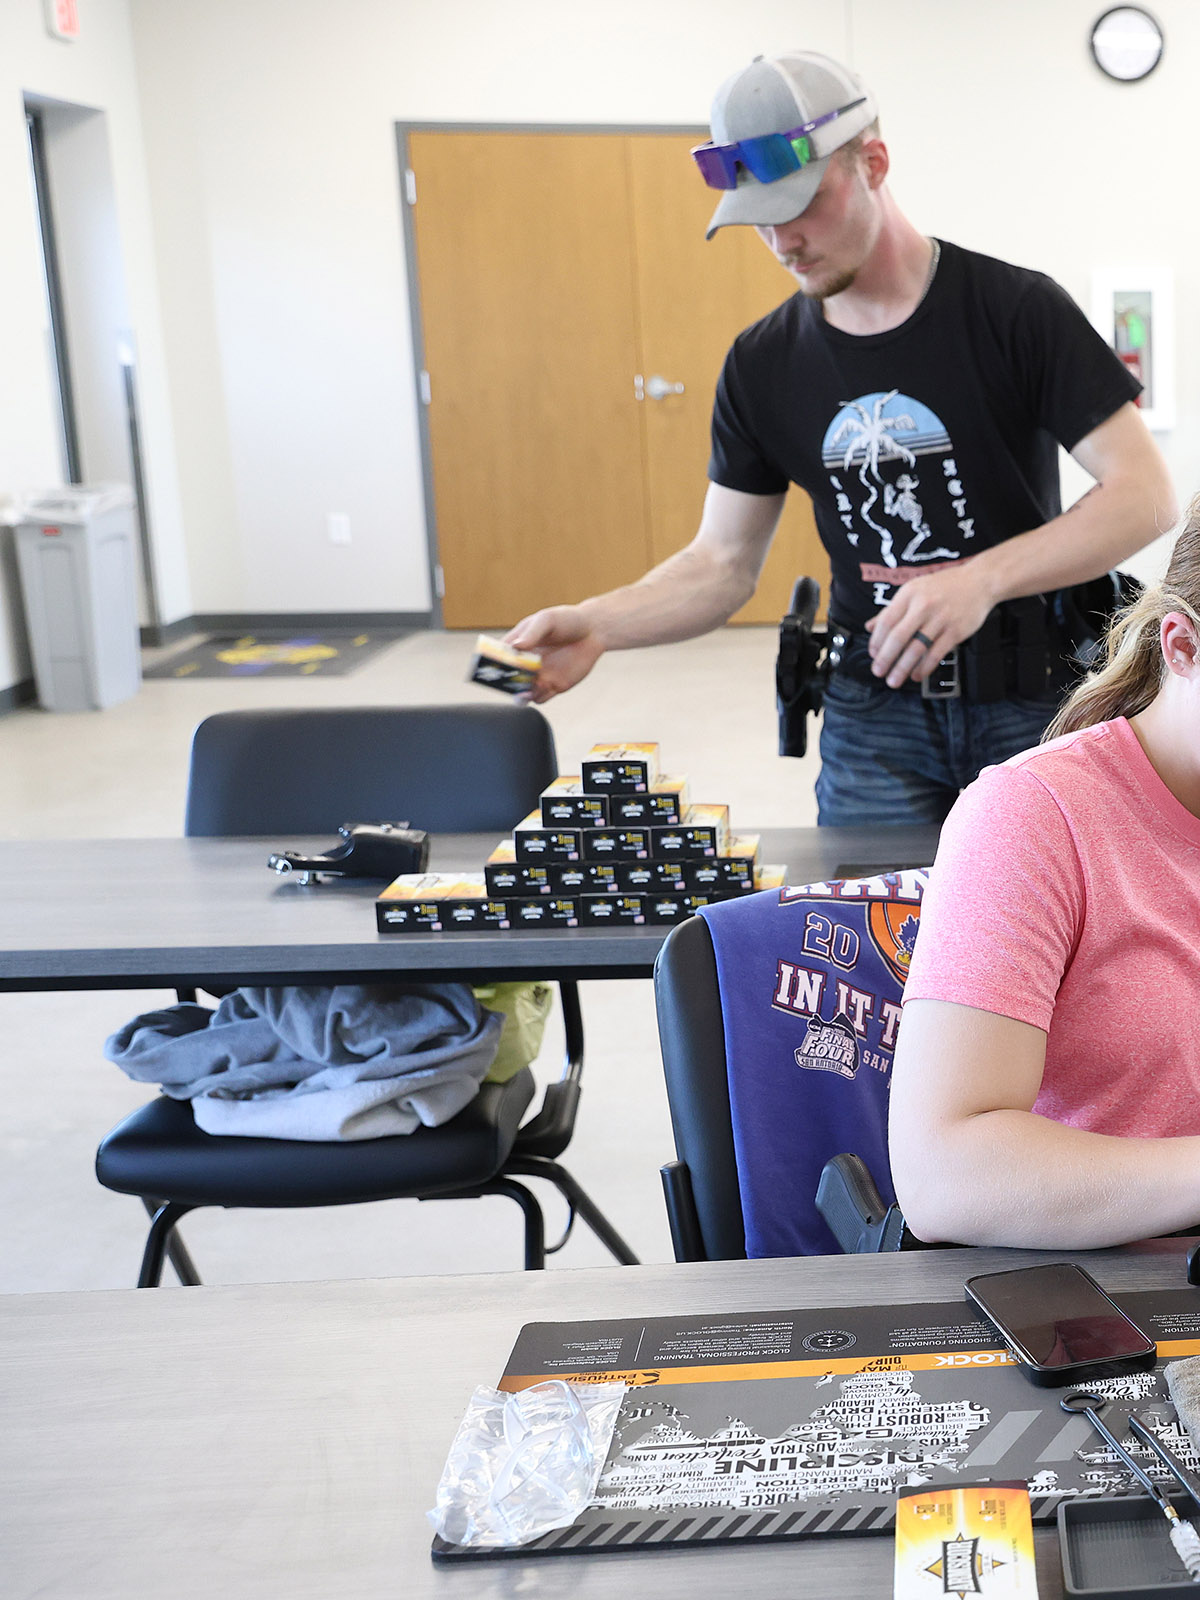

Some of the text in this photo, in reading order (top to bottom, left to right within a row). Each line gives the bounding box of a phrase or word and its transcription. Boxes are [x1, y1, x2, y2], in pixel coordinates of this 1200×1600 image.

[779, 868, 929, 902] AN
[801, 911, 860, 971] 20
[772, 961, 827, 1016] IN
[878, 1000, 903, 1053] T
[821, 1027, 855, 1051] FINAL
[802, 1036, 854, 1069] FOUR
[862, 1050, 890, 1073] SAN
[697, 1350, 760, 1358] PROFESSIONAL
[565, 1374, 637, 1382] ENTHUSIA
[1083, 1378, 1153, 1387] PRECISION
[817, 1404, 965, 1416] STRENGTH DRIVE
[875, 1412, 945, 1427] ROBUST
[900, 1424, 963, 1432] BRILLIANCE
[893, 1430, 958, 1439] Philosophy
[919, 1437, 959, 1447] TRUS
[770, 1442, 837, 1454] AUSTRIA
[661, 1447, 762, 1463] Perfection
[633, 1463, 708, 1474] GLOBAL
[714, 1452, 924, 1475] DISCIPLINE
[661, 1470, 703, 1479] RIMFIRE
[789, 1468, 873, 1477] MAINTENANCE
[683, 1480, 747, 1489] RELIABILITY
[755, 1476, 858, 1487] PERFECTION
[652, 1492, 738, 1503] DYNAMIC
[611, 1500, 637, 1508] GRIP
[946, 1541, 975, 1591] ARMSCOR
